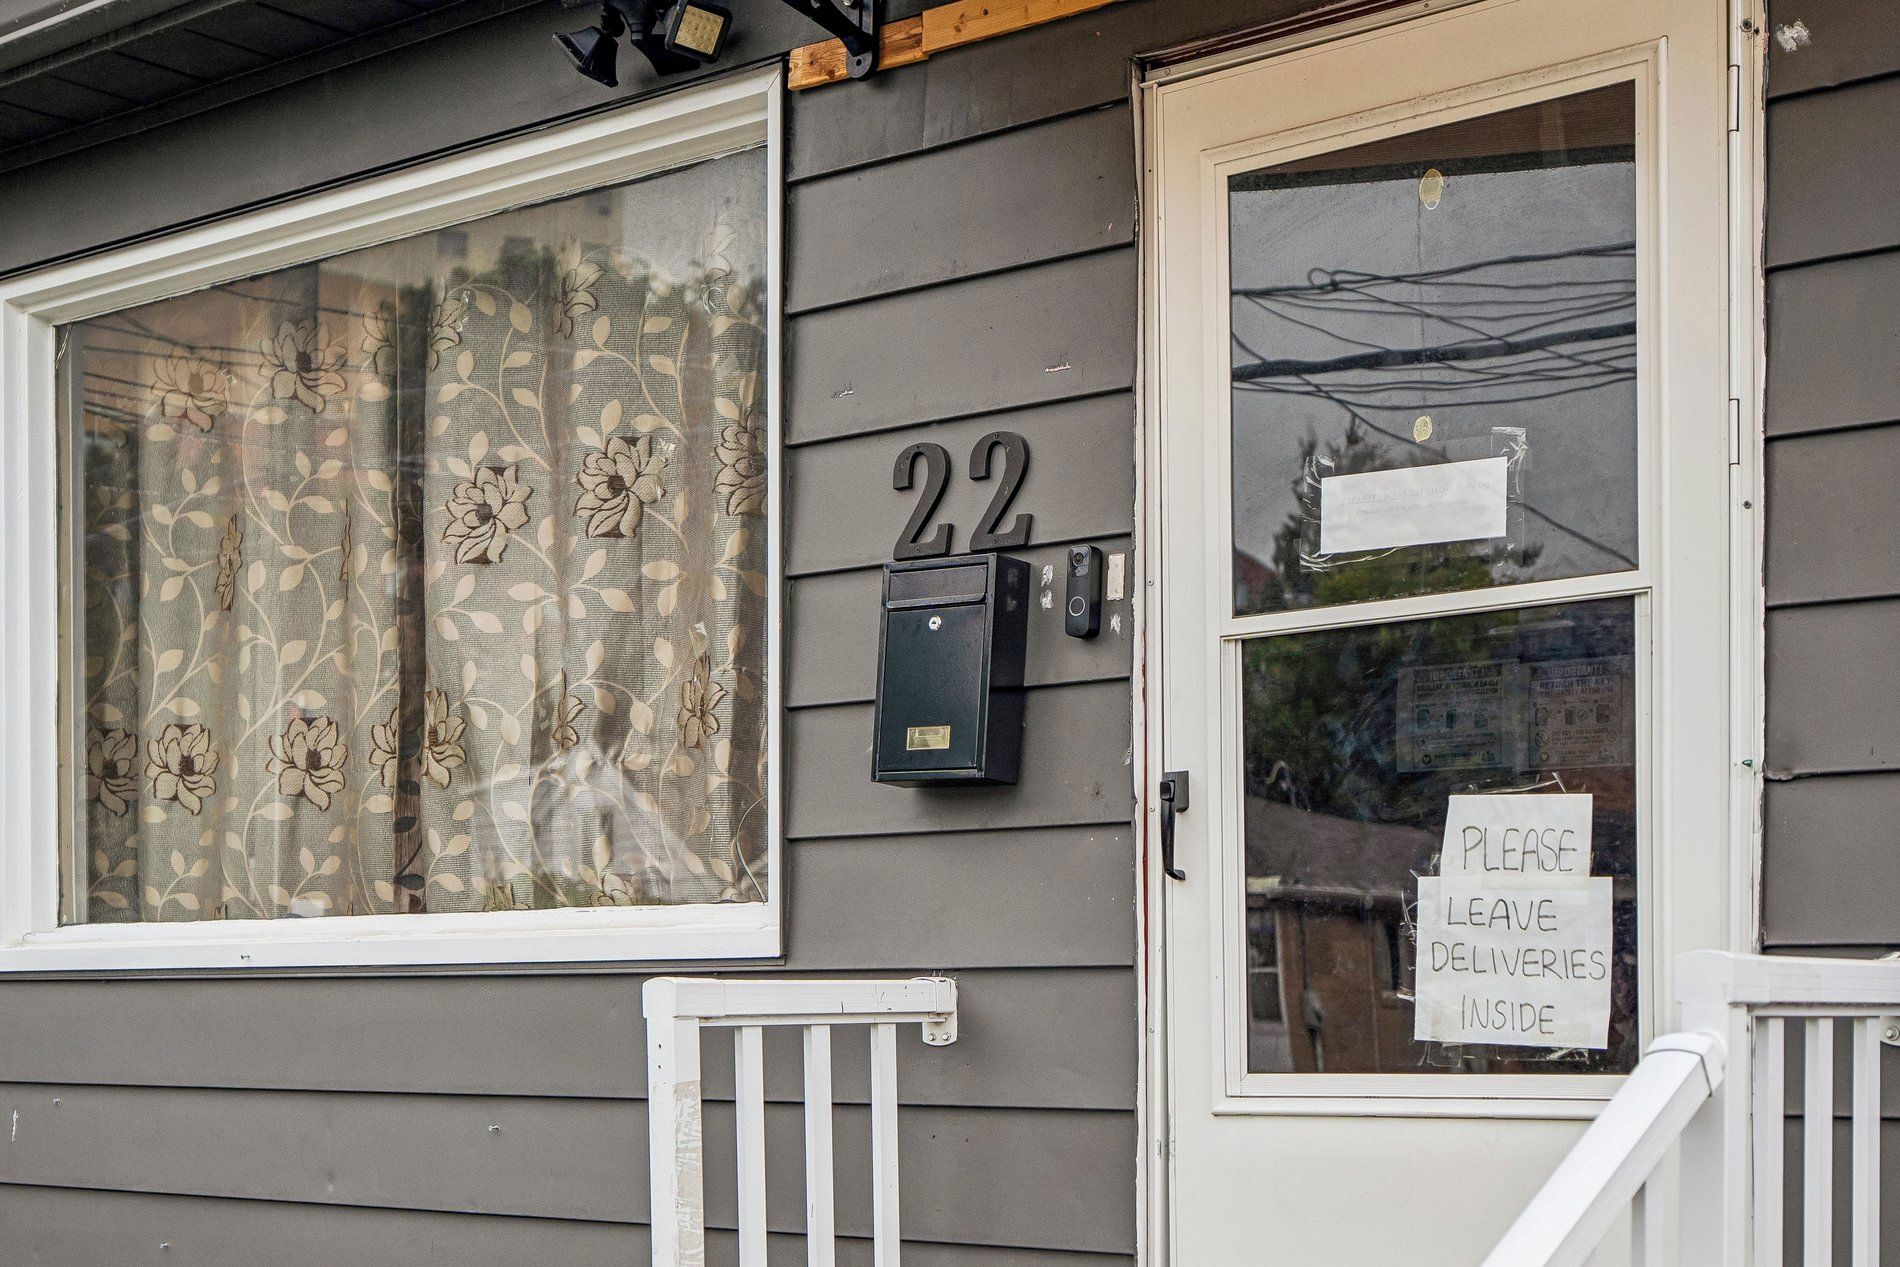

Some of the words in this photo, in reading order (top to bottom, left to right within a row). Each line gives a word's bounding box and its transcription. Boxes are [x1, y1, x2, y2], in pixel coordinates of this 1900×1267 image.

[892, 430, 1033, 562] 22
[1462, 825, 1578, 873] PLEASE
[1447, 896, 1557, 931] LEAVE
[1431, 941, 1607, 980] DELIVERIES
[1461, 994, 1555, 1035] INSIDE
